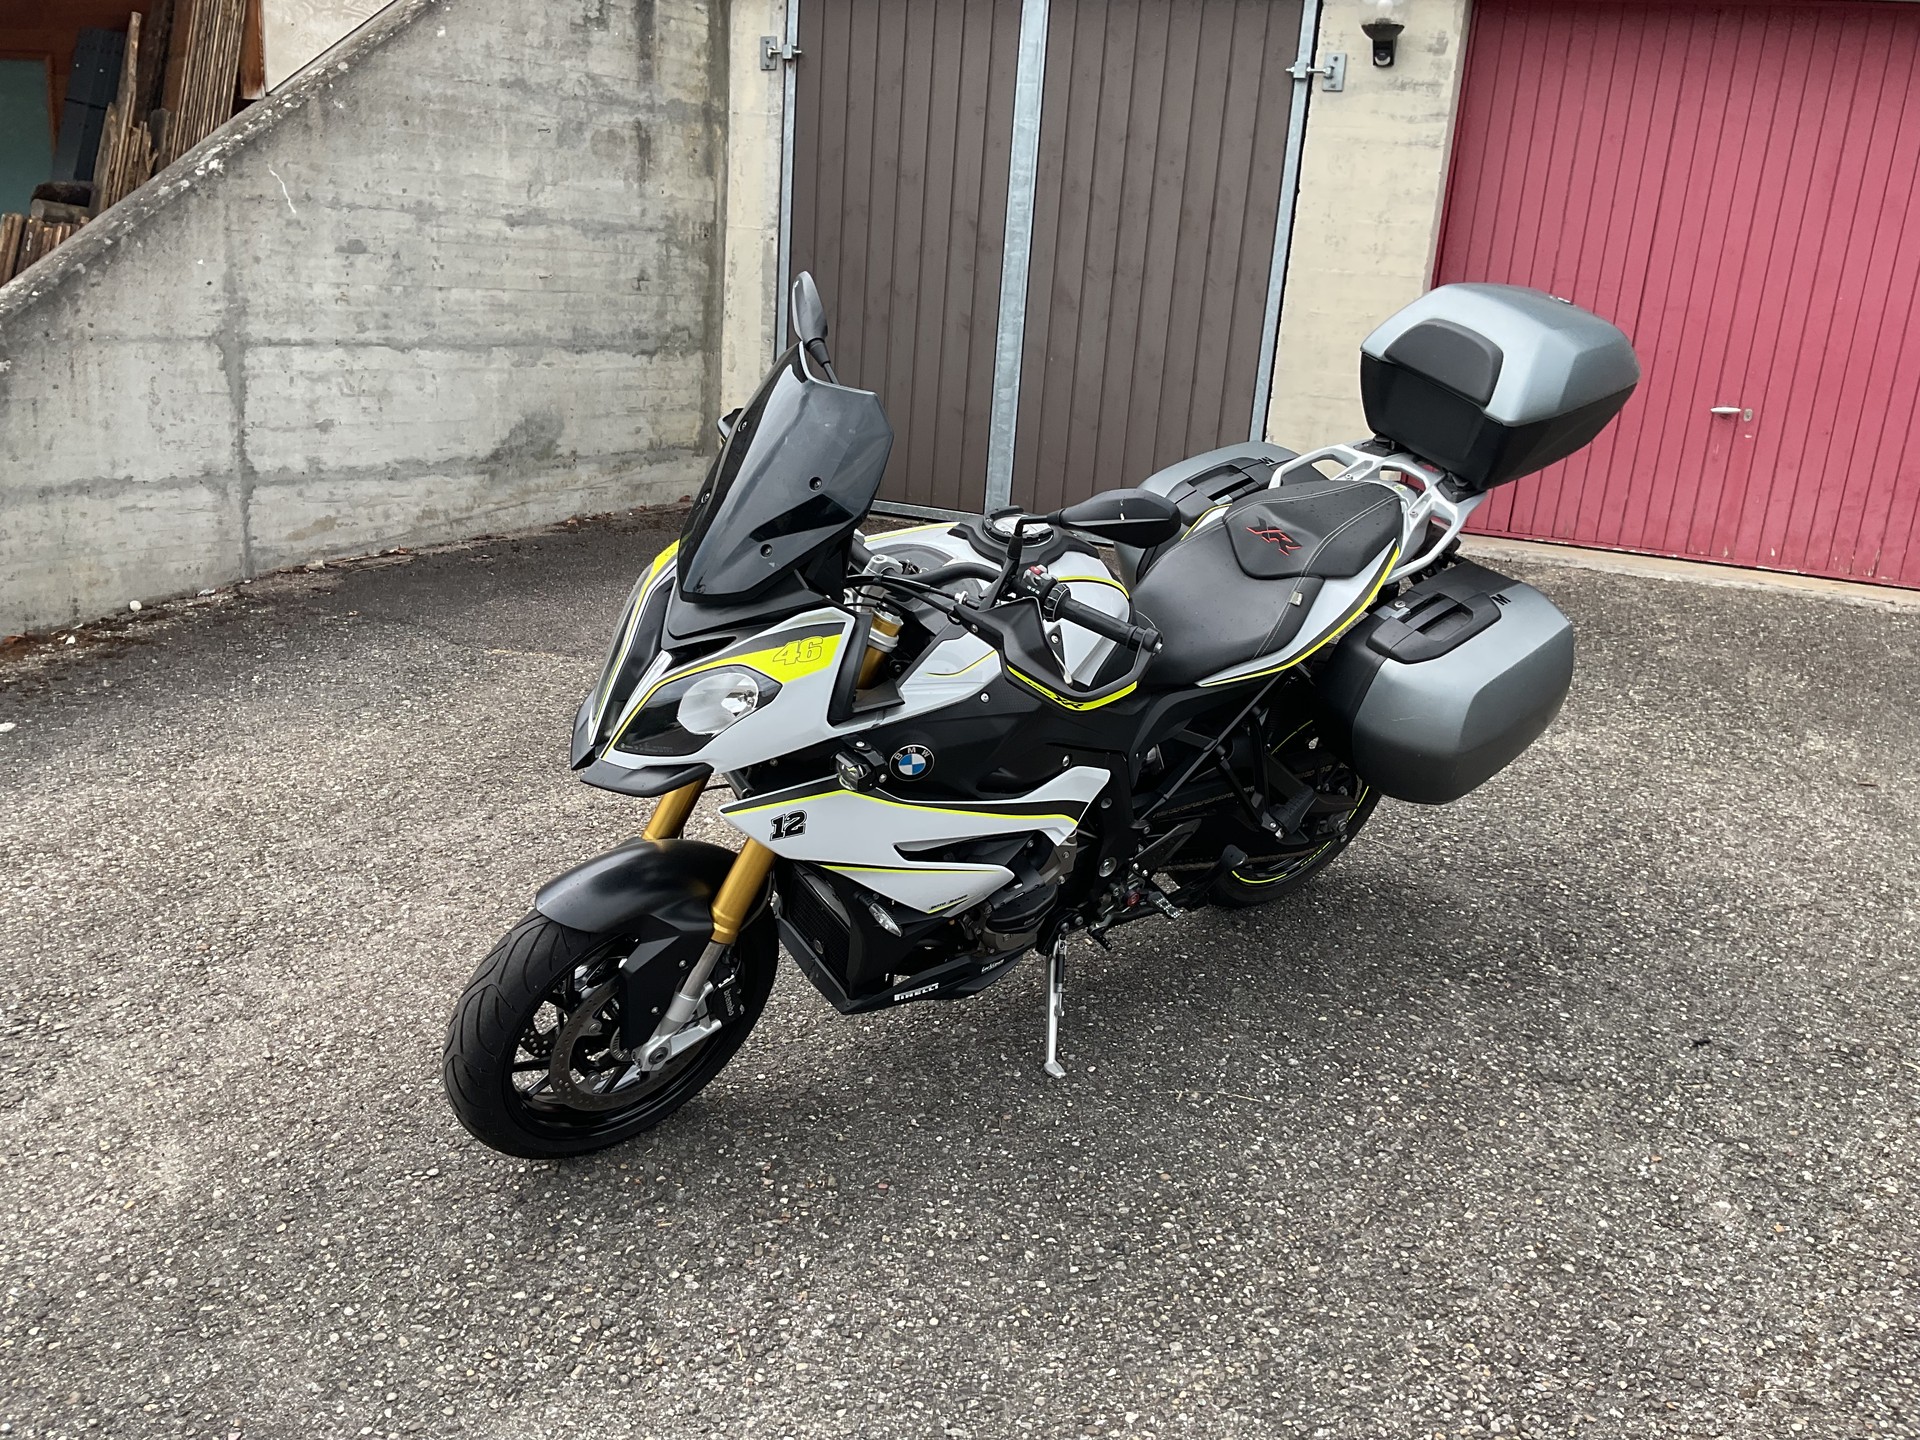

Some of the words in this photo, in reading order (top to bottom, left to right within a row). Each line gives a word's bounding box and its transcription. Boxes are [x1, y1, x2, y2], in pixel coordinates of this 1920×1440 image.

[1246, 516, 1303, 556] XR
[772, 636, 823, 665] 46
[894, 746, 931, 761] BMW
[769, 809, 807, 841] 12
